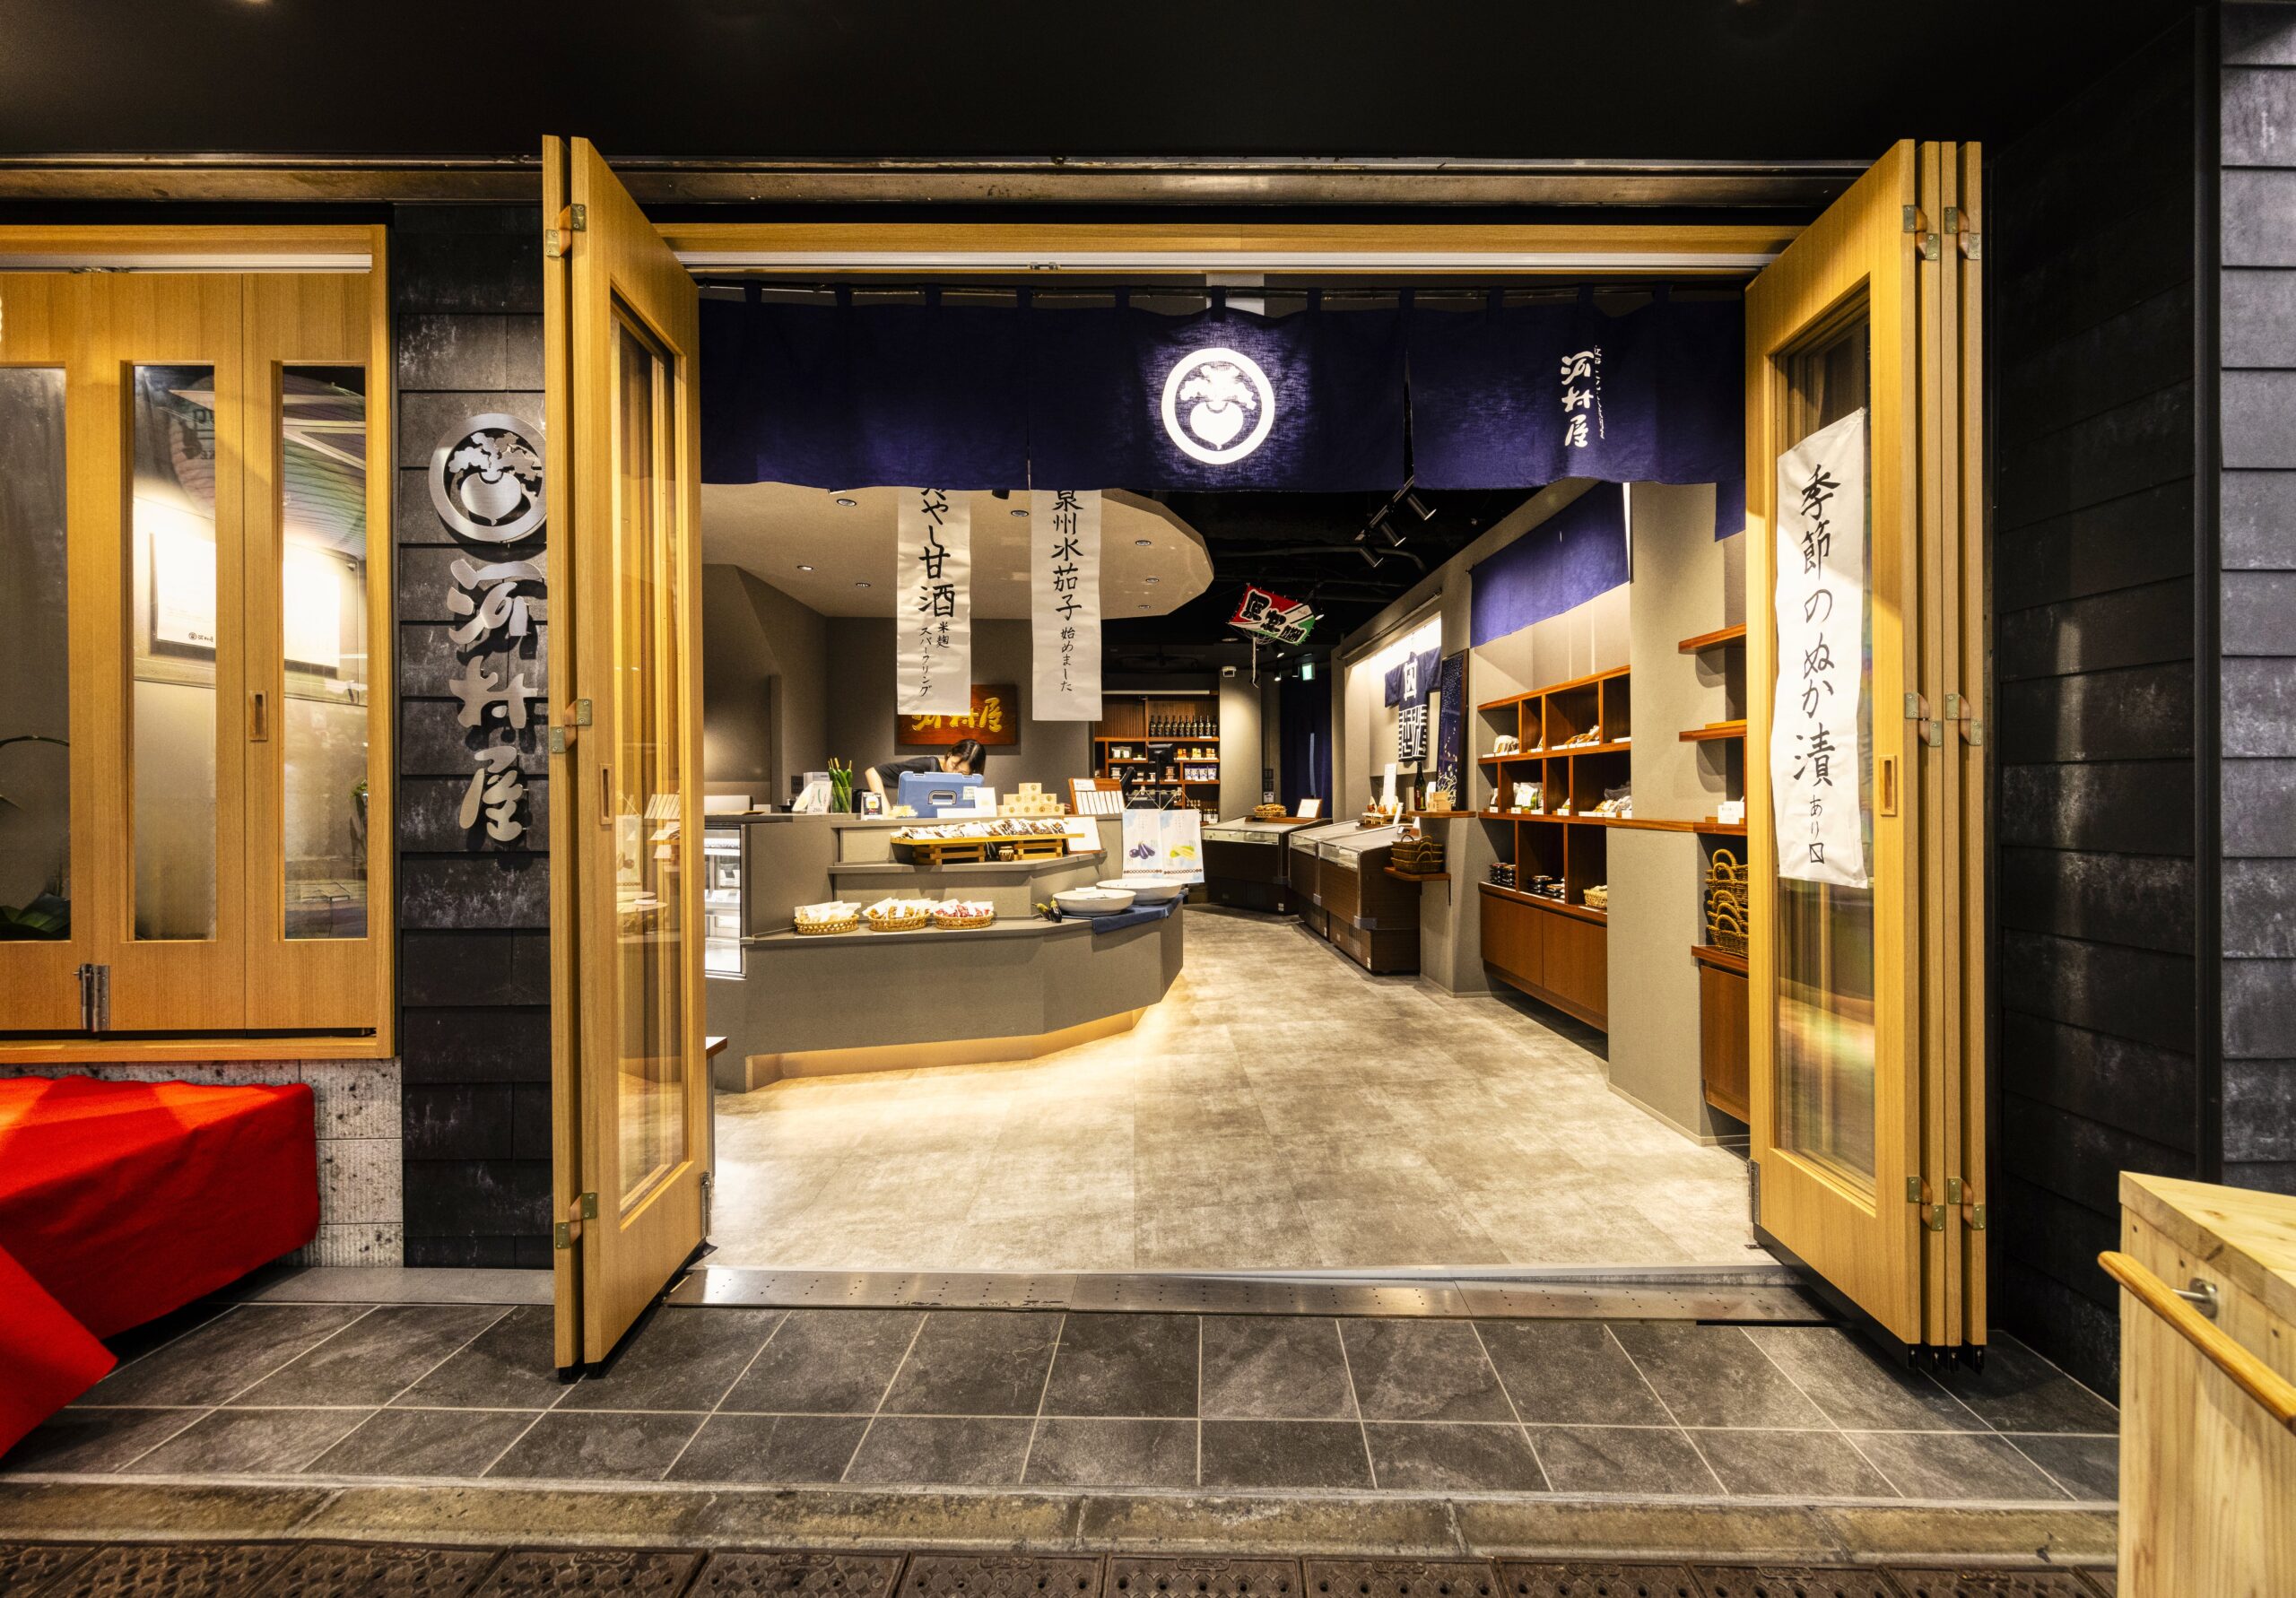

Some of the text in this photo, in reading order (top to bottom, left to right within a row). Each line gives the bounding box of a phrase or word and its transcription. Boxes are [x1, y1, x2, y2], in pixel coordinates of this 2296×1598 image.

[1561, 351, 1594, 447] 河村屋
[447, 559, 543, 841] 河村屋
[1051, 490, 1084, 692] 泉州水茄子 始めました
[1793, 464, 1841, 787] 季節のぬか漬
